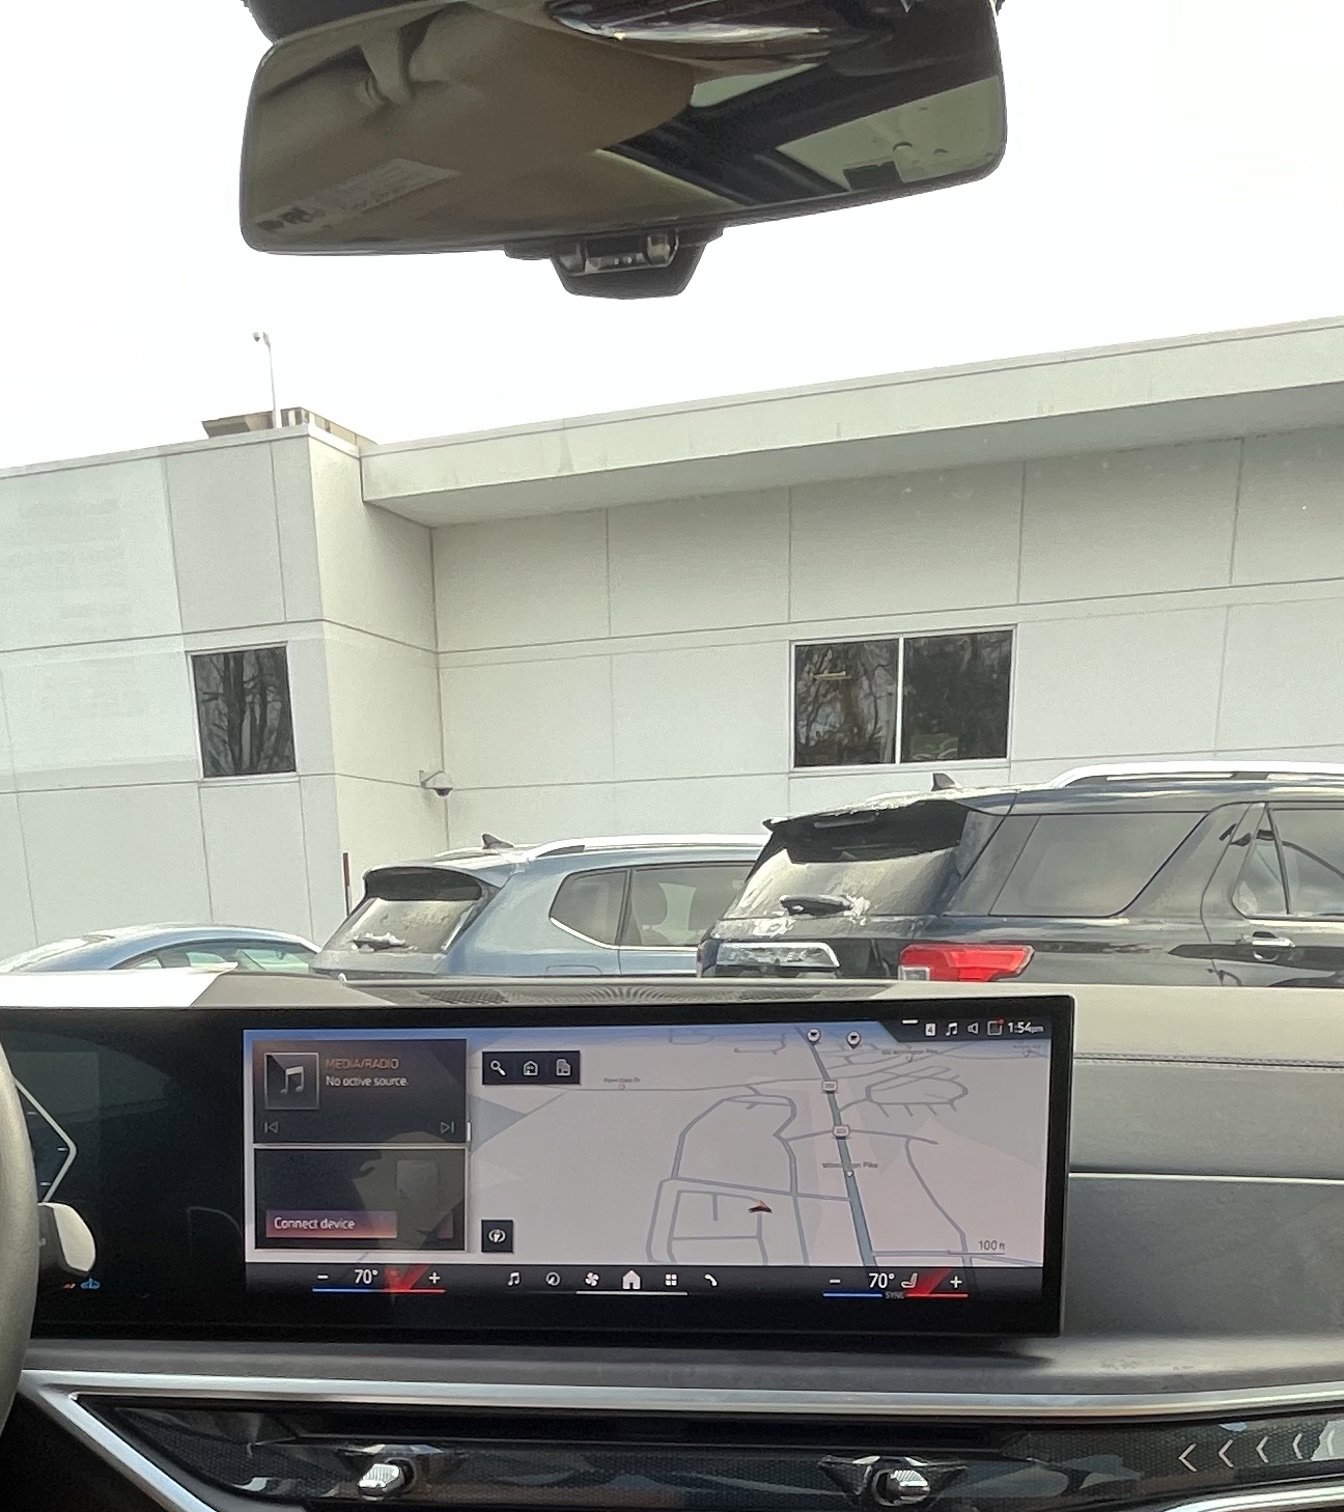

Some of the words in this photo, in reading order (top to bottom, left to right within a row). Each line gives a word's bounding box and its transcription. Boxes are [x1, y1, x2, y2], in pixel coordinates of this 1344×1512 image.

[325, 1057, 400, 1070] MEDIA/RADIO
[325, 1075, 341, 1087] No
[342, 1075, 372, 1087] active
[273, 1216, 318, 1230] Connect
[320, 1216, 356, 1229] device
[978, 1239, 998, 1251] 100
[354, 1268, 379, 1285] 70°
[868, 1272, 895, 1289] 70°
